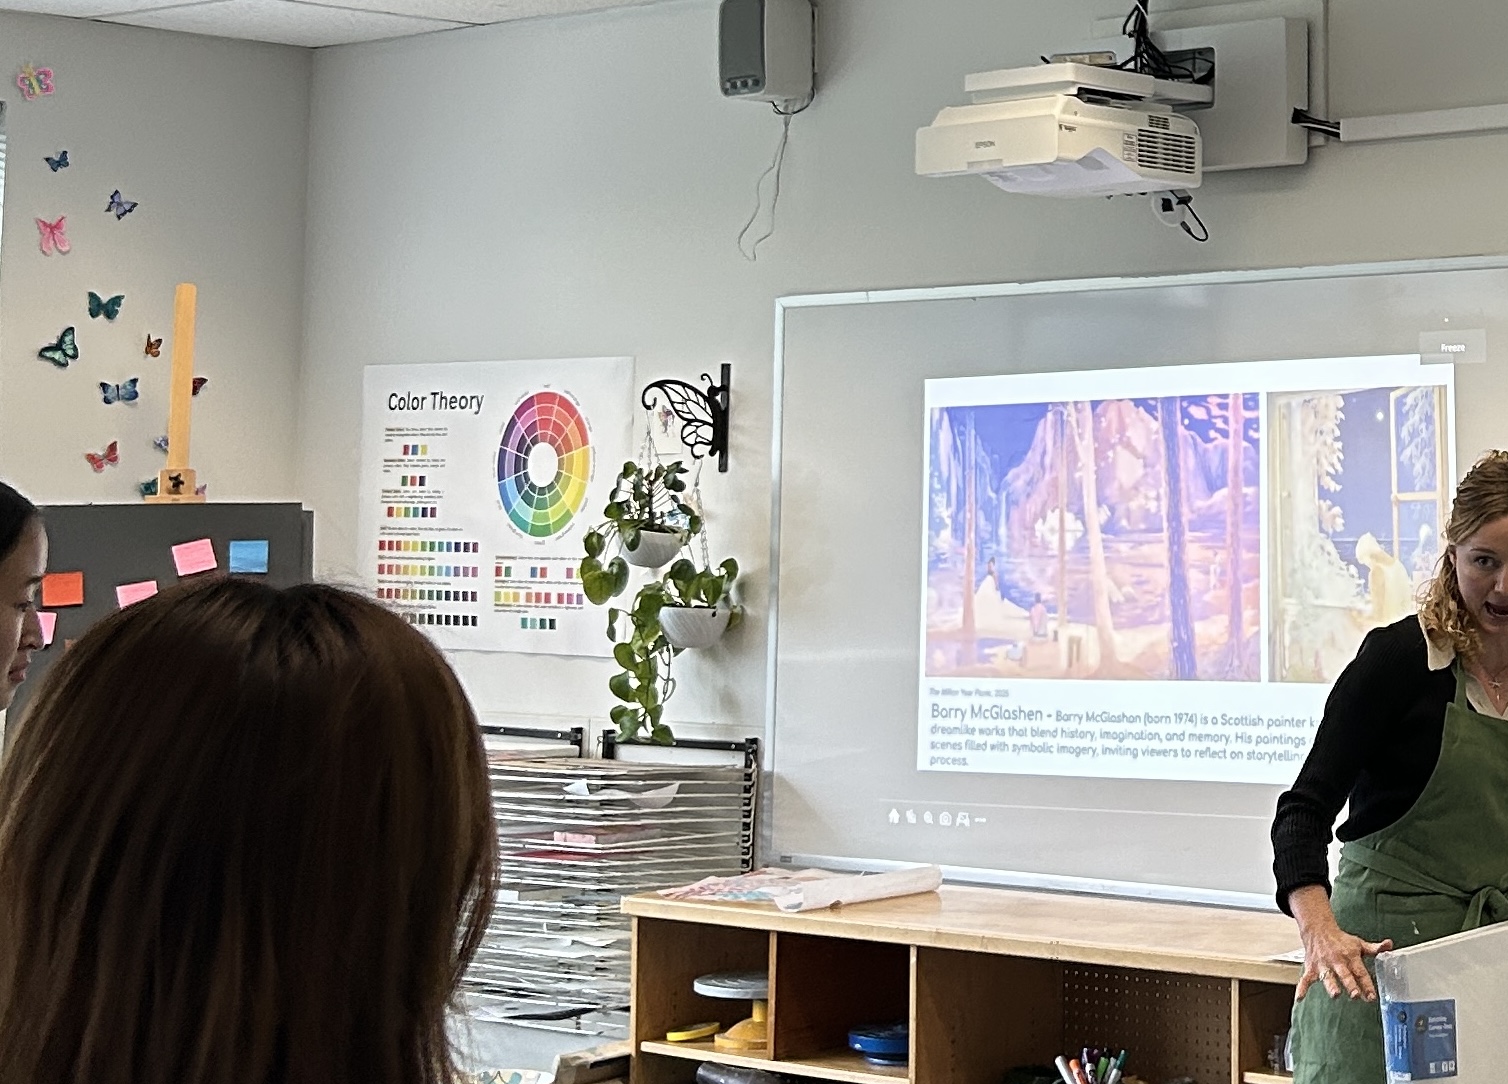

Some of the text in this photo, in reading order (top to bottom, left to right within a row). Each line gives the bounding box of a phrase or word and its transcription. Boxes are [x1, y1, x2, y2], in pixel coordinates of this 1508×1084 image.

[1441, 343, 1466, 353] Freeze
[388, 390, 484, 415] Color Theory
[931, 703, 967, 722] Barry
[971, 703, 1043, 721] McGlashen
[1056, 710, 1084, 726] Barry
[1085, 711, 1141, 725] McGlashan
[1143, 711, 1171, 727] (born
[1173, 712, 1198, 728] 1974)
[1200, 713, 1209, 726] is
[1211, 717, 1219, 726] a
[1221, 713, 1264, 727] Scottish
[1267, 715, 1307, 730] painter
[931, 723, 976, 736] dreamlike
[978, 725, 1006, 737] works
[1008, 726, 1028, 738] that
[1030, 726, 1059, 739] blend
[1165, 730, 1185, 742] and
[1235, 731, 1253, 745] His
[1255, 733, 1307, 749] paintings
[930, 740, 963, 751] scenes
[964, 739, 988, 751] filled
[990, 740, 1010, 752] with
[1012, 741, 1054, 756] symbolic
[1101, 744, 1139, 759] inviting
[1141, 745, 1179, 758] viewers
[1181, 747, 1192, 758] to
[1194, 746, 1227, 760] reflect
[1230, 749, 1244, 760] on
